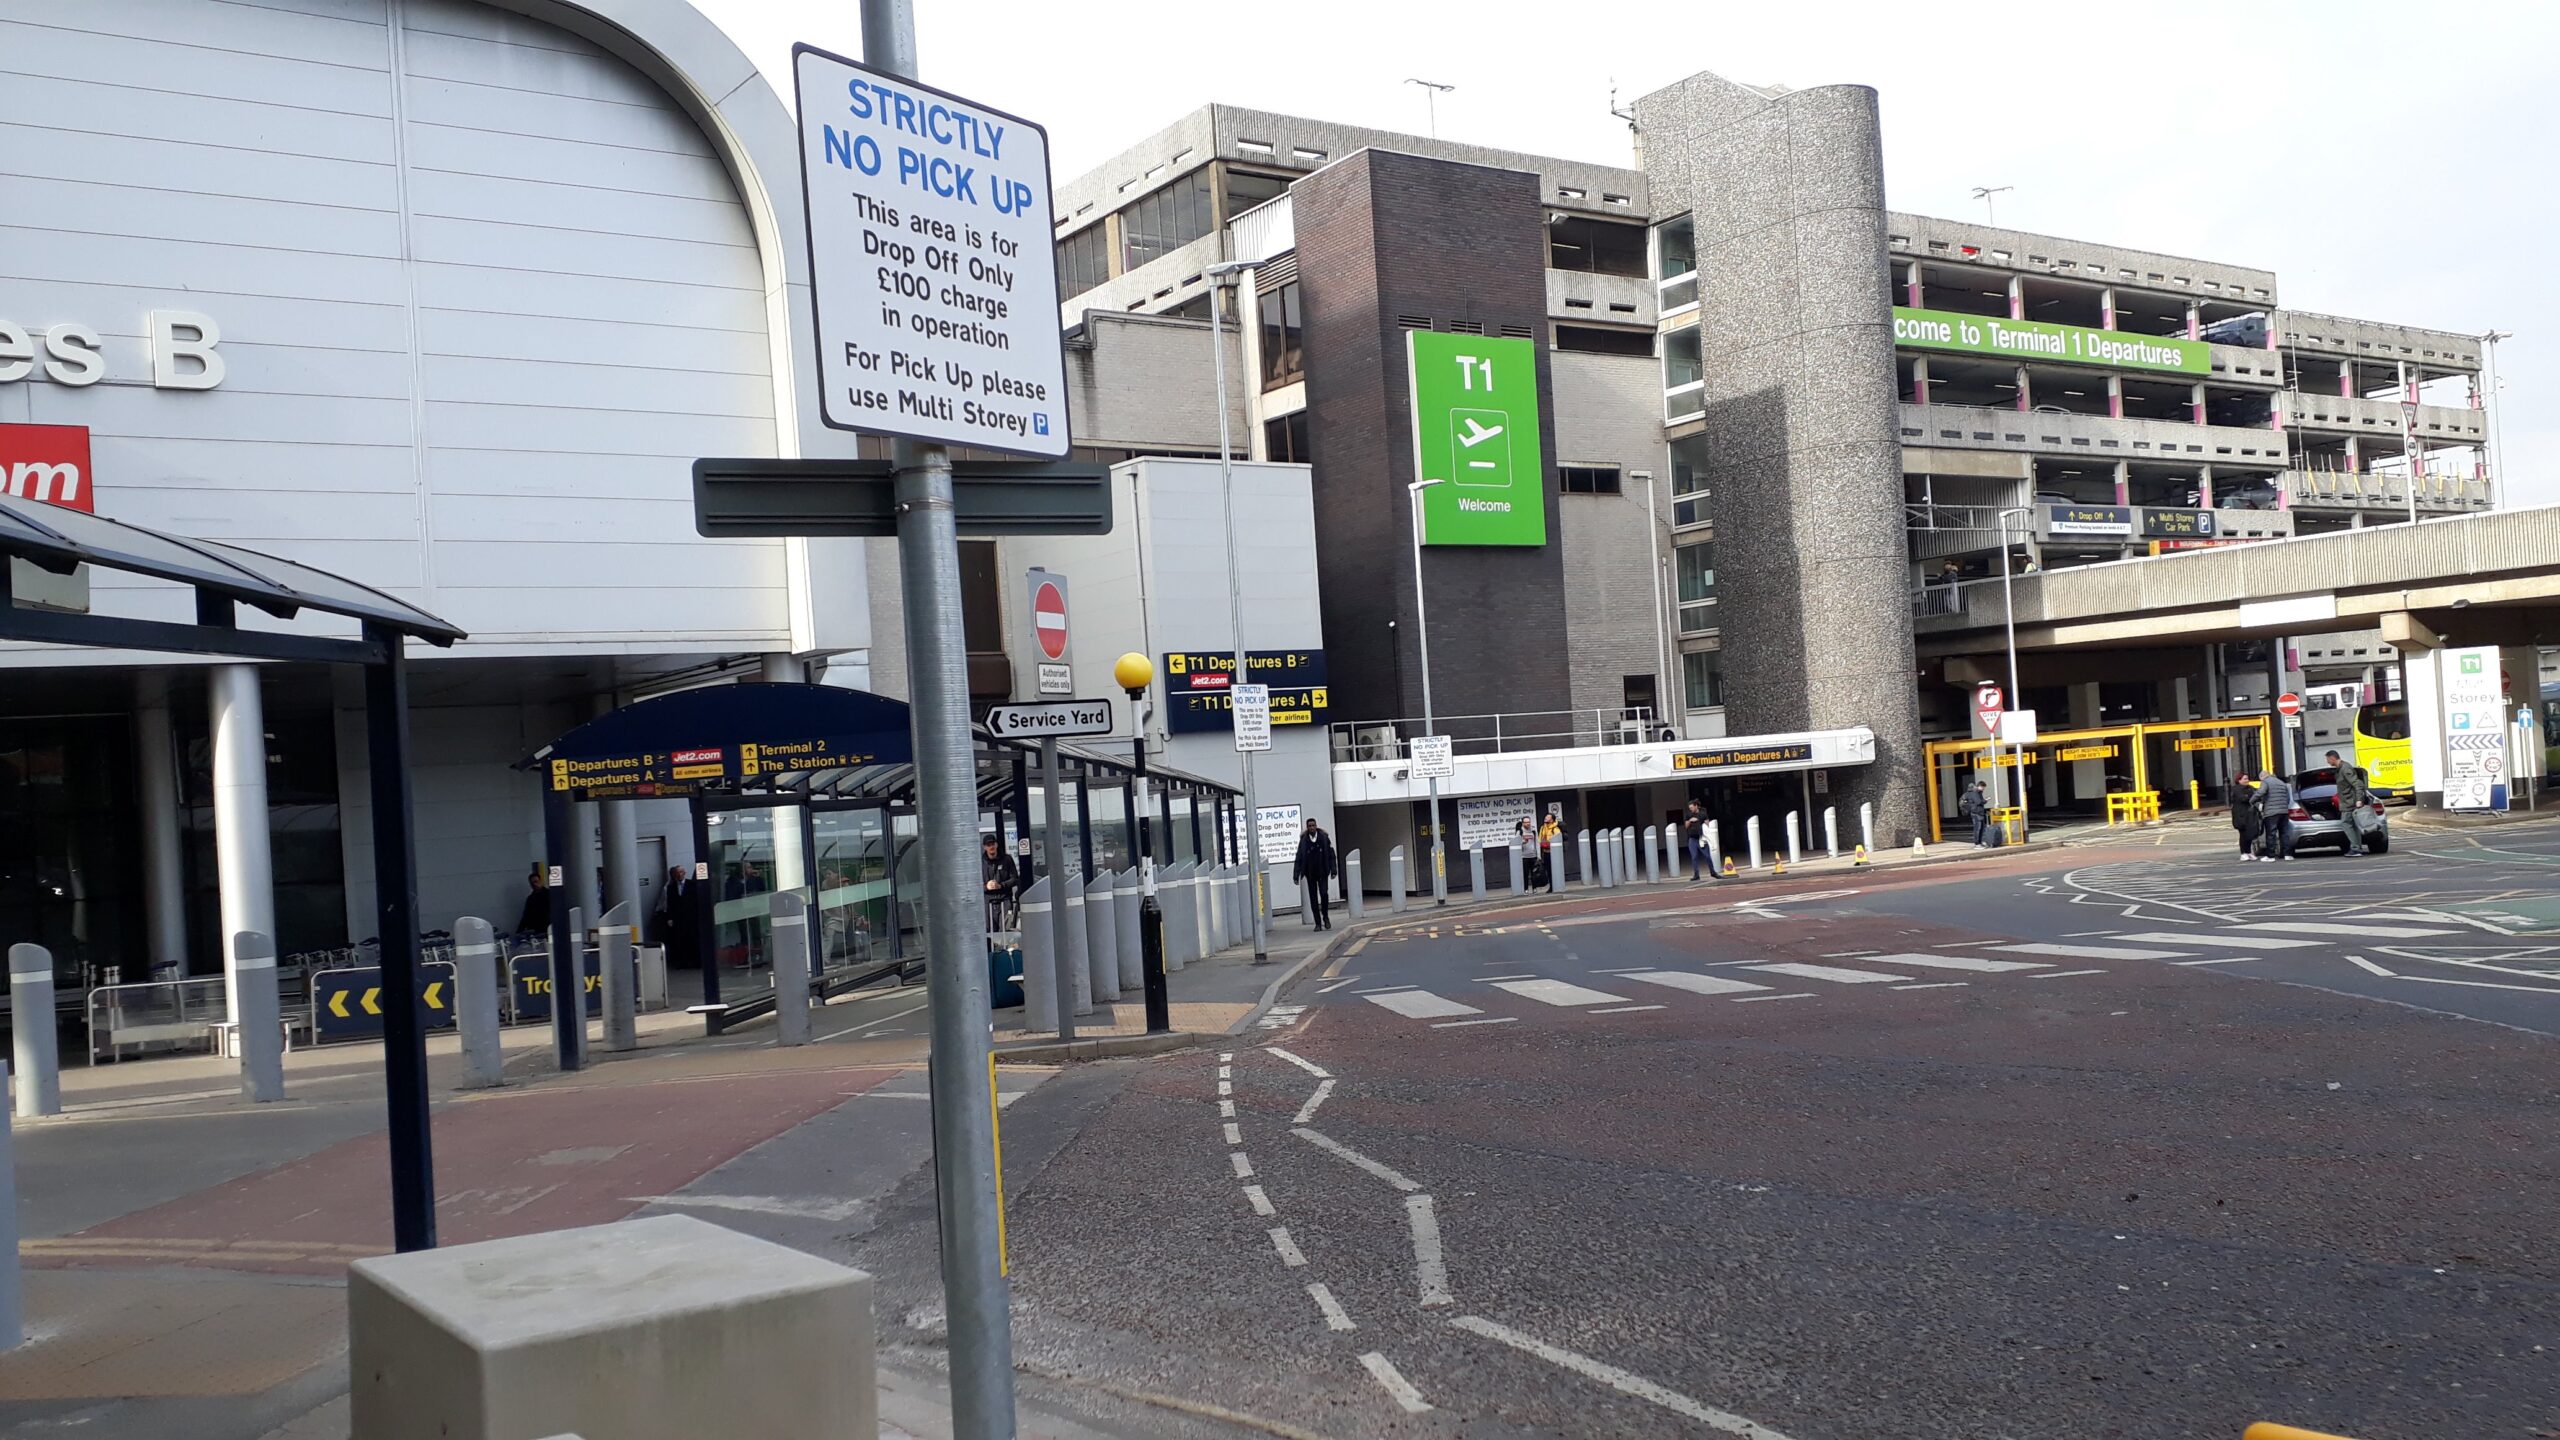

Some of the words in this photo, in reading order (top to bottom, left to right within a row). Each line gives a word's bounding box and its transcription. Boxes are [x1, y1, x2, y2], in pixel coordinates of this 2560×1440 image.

[849, 79, 1004, 160] STRICTLY
[824, 125, 881, 176] NO
[898, 146, 977, 205] PICK
[991, 174, 1032, 218] UP
[852, 192, 899, 227] This
[910, 215, 956, 242] area
[965, 223, 982, 249] is
[991, 231, 1018, 258] for
[863, 229, 915, 267] Drop
[925, 246, 959, 275] Off
[969, 257, 1013, 292] Only
[877, 267, 931, 301] £100
[941, 284, 1007, 320] charge
[882, 301, 901, 328] in
[912, 314, 1009, 350] operation
[0, 319, 106, 387] es
[151, 309, 226, 391] B
[1959, 320, 1981, 345] to
[1987, 321, 2066, 354] Terminal
[2072, 335, 2081, 355] 1
[2088, 336, 2182, 367] Departures
[845, 341, 881, 371] For
[891, 350, 937, 382] Pick
[946, 361, 973, 392] Up
[982, 370, 1046, 401] please
[1456, 355, 1493, 391] T1
[849, 387, 888, 410] use
[898, 389, 953, 421] Multi
[963, 401, 1027, 437] Storey
[0, 462, 80, 501] m
[1458, 498, 1511, 512] Welcome
[2078, 512, 2092, 521] Drop
[2094, 512, 2103, 520] Off
[2159, 513, 2174, 522] Multi
[2175, 513, 2195, 523] Storey
[2165, 523, 2176, 531] Car
[2177, 523, 2191, 532] Park
[1188, 657, 1203, 670] T1
[1209, 656, 1282, 672] Deprtures
[1287, 654, 1297, 667] B
[2463, 658, 2480, 670] T1
[1192, 677, 1228, 685] Jet2.com
[1238, 686, 1261, 694] STRICTLY
[2450, 693, 2496, 704] Storey
[1203, 696, 1218, 710] T1
[1223, 695, 1296, 709] Dures
[1301, 693, 1310, 706] A
[1235, 696, 1243, 704] NO
[1245, 696, 1256, 704] PICK
[1259, 696, 1266, 704] UP
[1009, 712, 1066, 729] Service
[1071, 709, 1104, 725] Yard
[1270, 713, 1283, 722] her
[1284, 713, 1309, 722] airlines
[759, 741, 812, 757] Terminal
[817, 740, 826, 752] 2
[1687, 755, 1723, 766] Terminal
[1726, 753, 1731, 763] 1
[1734, 750, 1781, 764] Departures
[1784, 748, 1790, 758] A
[568, 757, 639, 773] Departures
[643, 754, 654, 766] B
[673, 751, 720, 762] Jet2.com
[760, 759, 785, 772] The
[790, 755, 835, 770] Station
[570, 772, 640, 787] Departures
[644, 771, 654, 781] A
[1460, 801, 1490, 810] STRICTLY
[1266, 811, 1284, 820] PICK
[1287, 810, 1298, 818] UP
